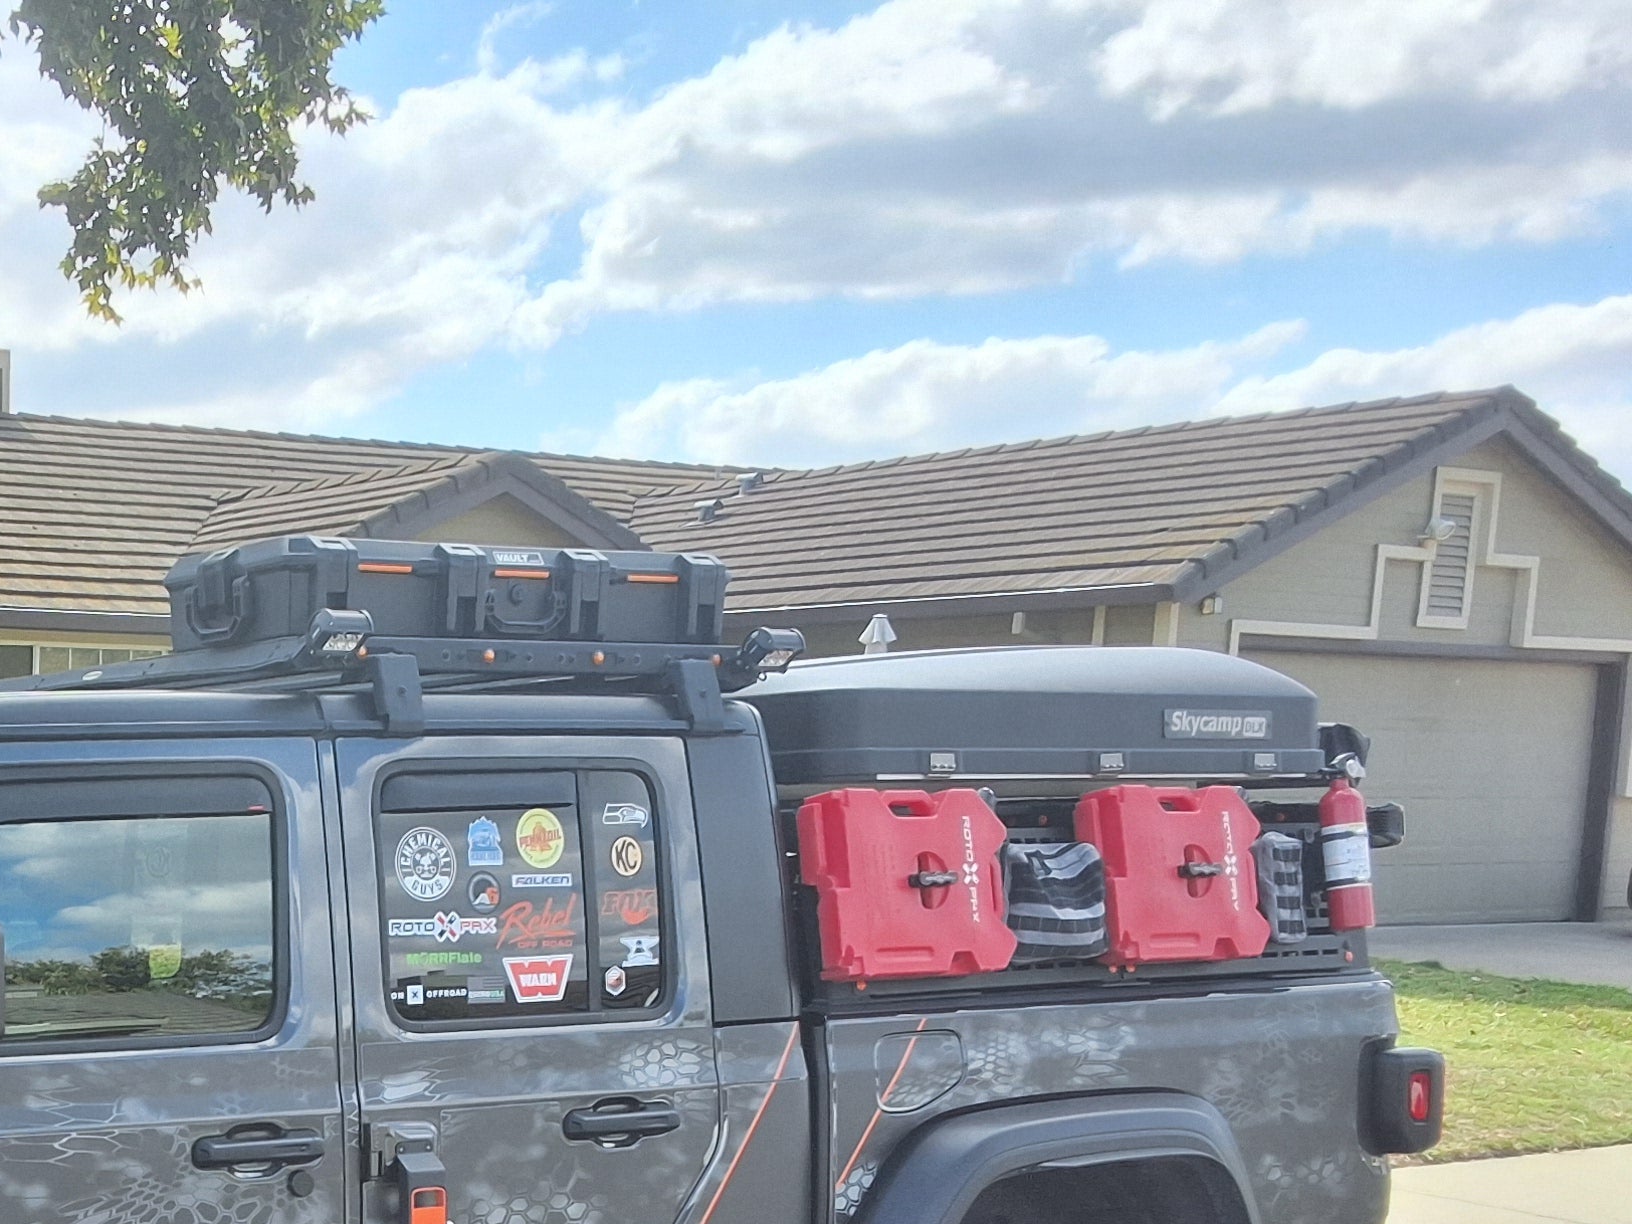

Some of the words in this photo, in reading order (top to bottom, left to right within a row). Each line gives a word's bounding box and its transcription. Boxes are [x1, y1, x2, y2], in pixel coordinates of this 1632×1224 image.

[496, 553, 529, 563] VAULT
[1171, 710, 1243, 736] Skycamp
[1244, 719, 1265, 735] DLX
[961, 815, 974, 862] ROTO
[400, 832, 452, 867] CHEMICAL
[617, 839, 638, 872] KC
[411, 879, 443, 895] GUYS
[515, 875, 570, 886] FALKEN
[391, 921, 436, 933] ROTO
[460, 920, 494, 931] PAX
[496, 892, 577, 950] Rebel
[517, 972, 557, 987] WARN
[426, 988, 468, 998] OFFROAD
